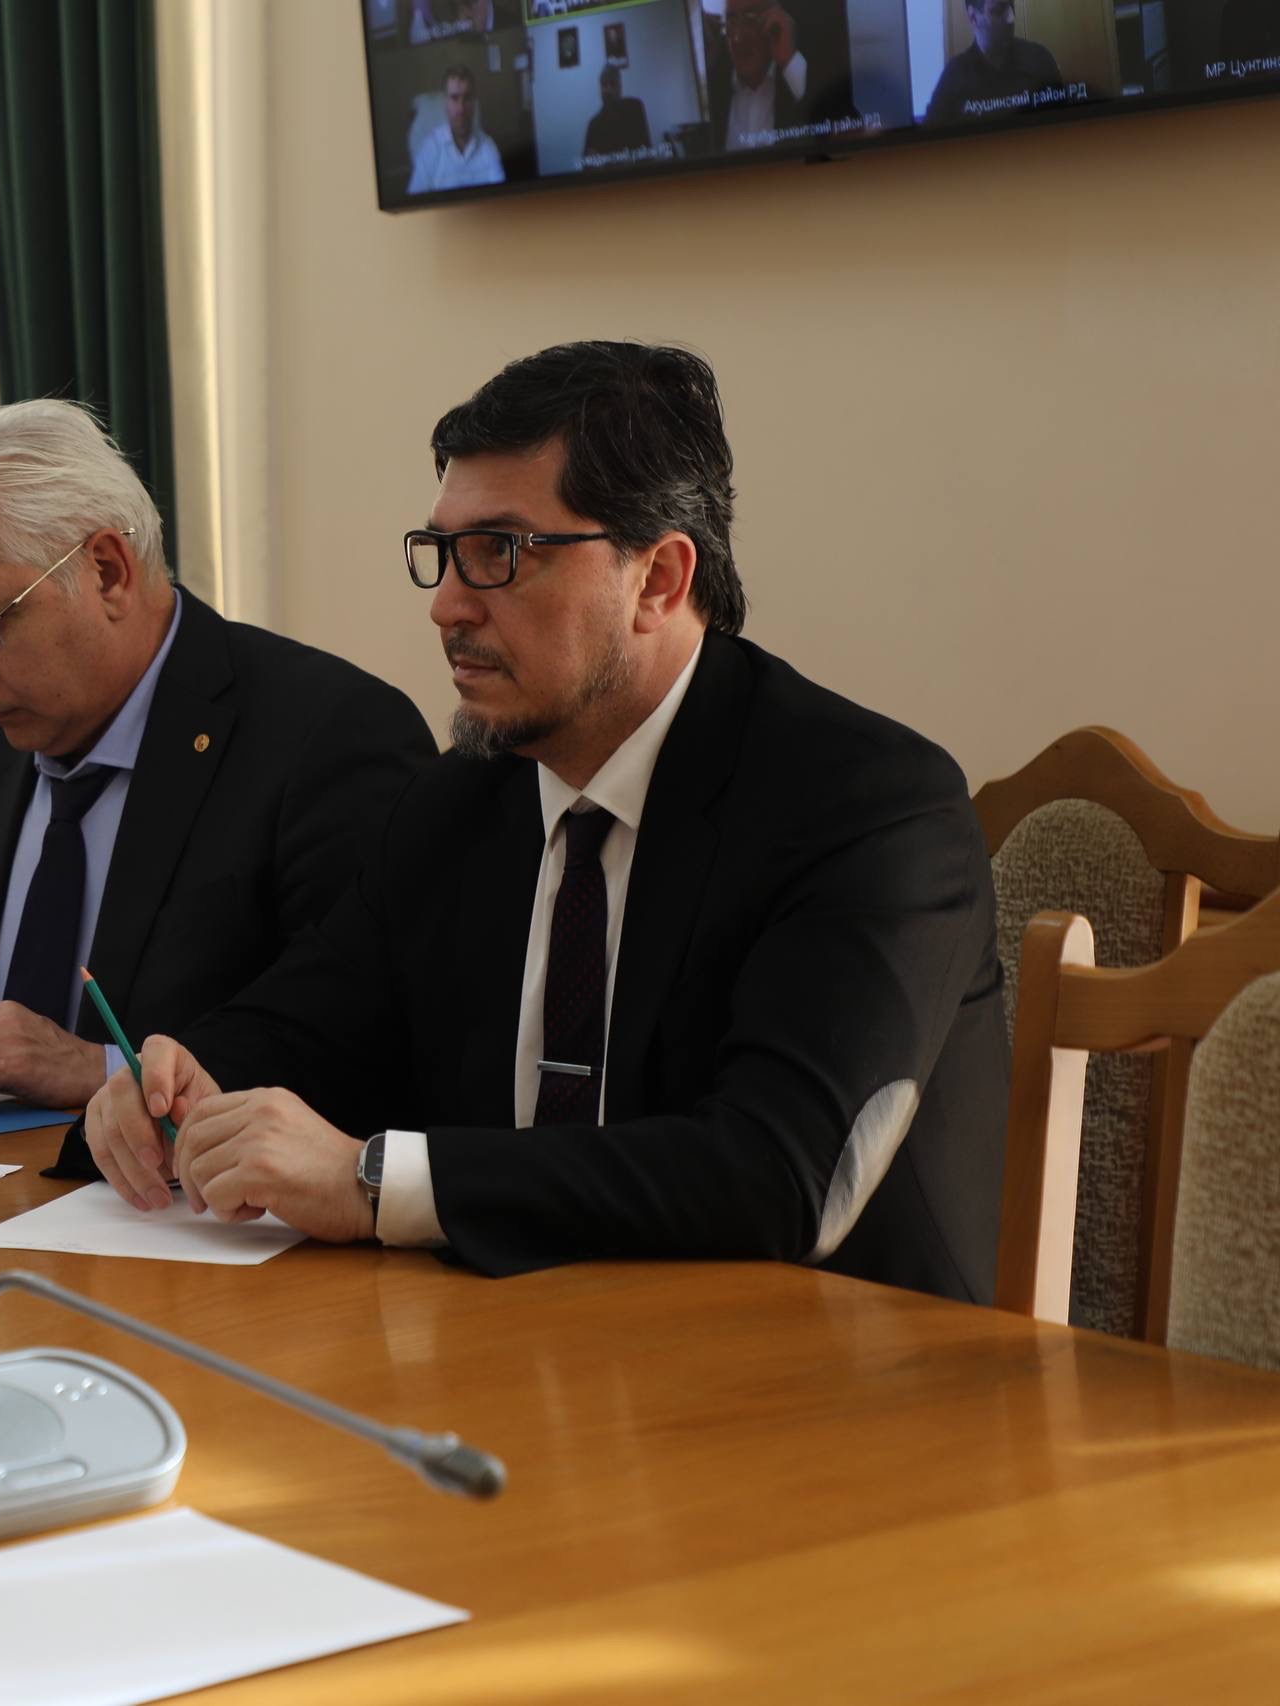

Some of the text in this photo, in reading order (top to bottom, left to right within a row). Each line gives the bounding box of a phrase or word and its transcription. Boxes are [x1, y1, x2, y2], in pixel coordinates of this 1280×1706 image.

[1206, 62, 1226, 79] МР
[964, 81, 1087, 117] Акушинский район РД
